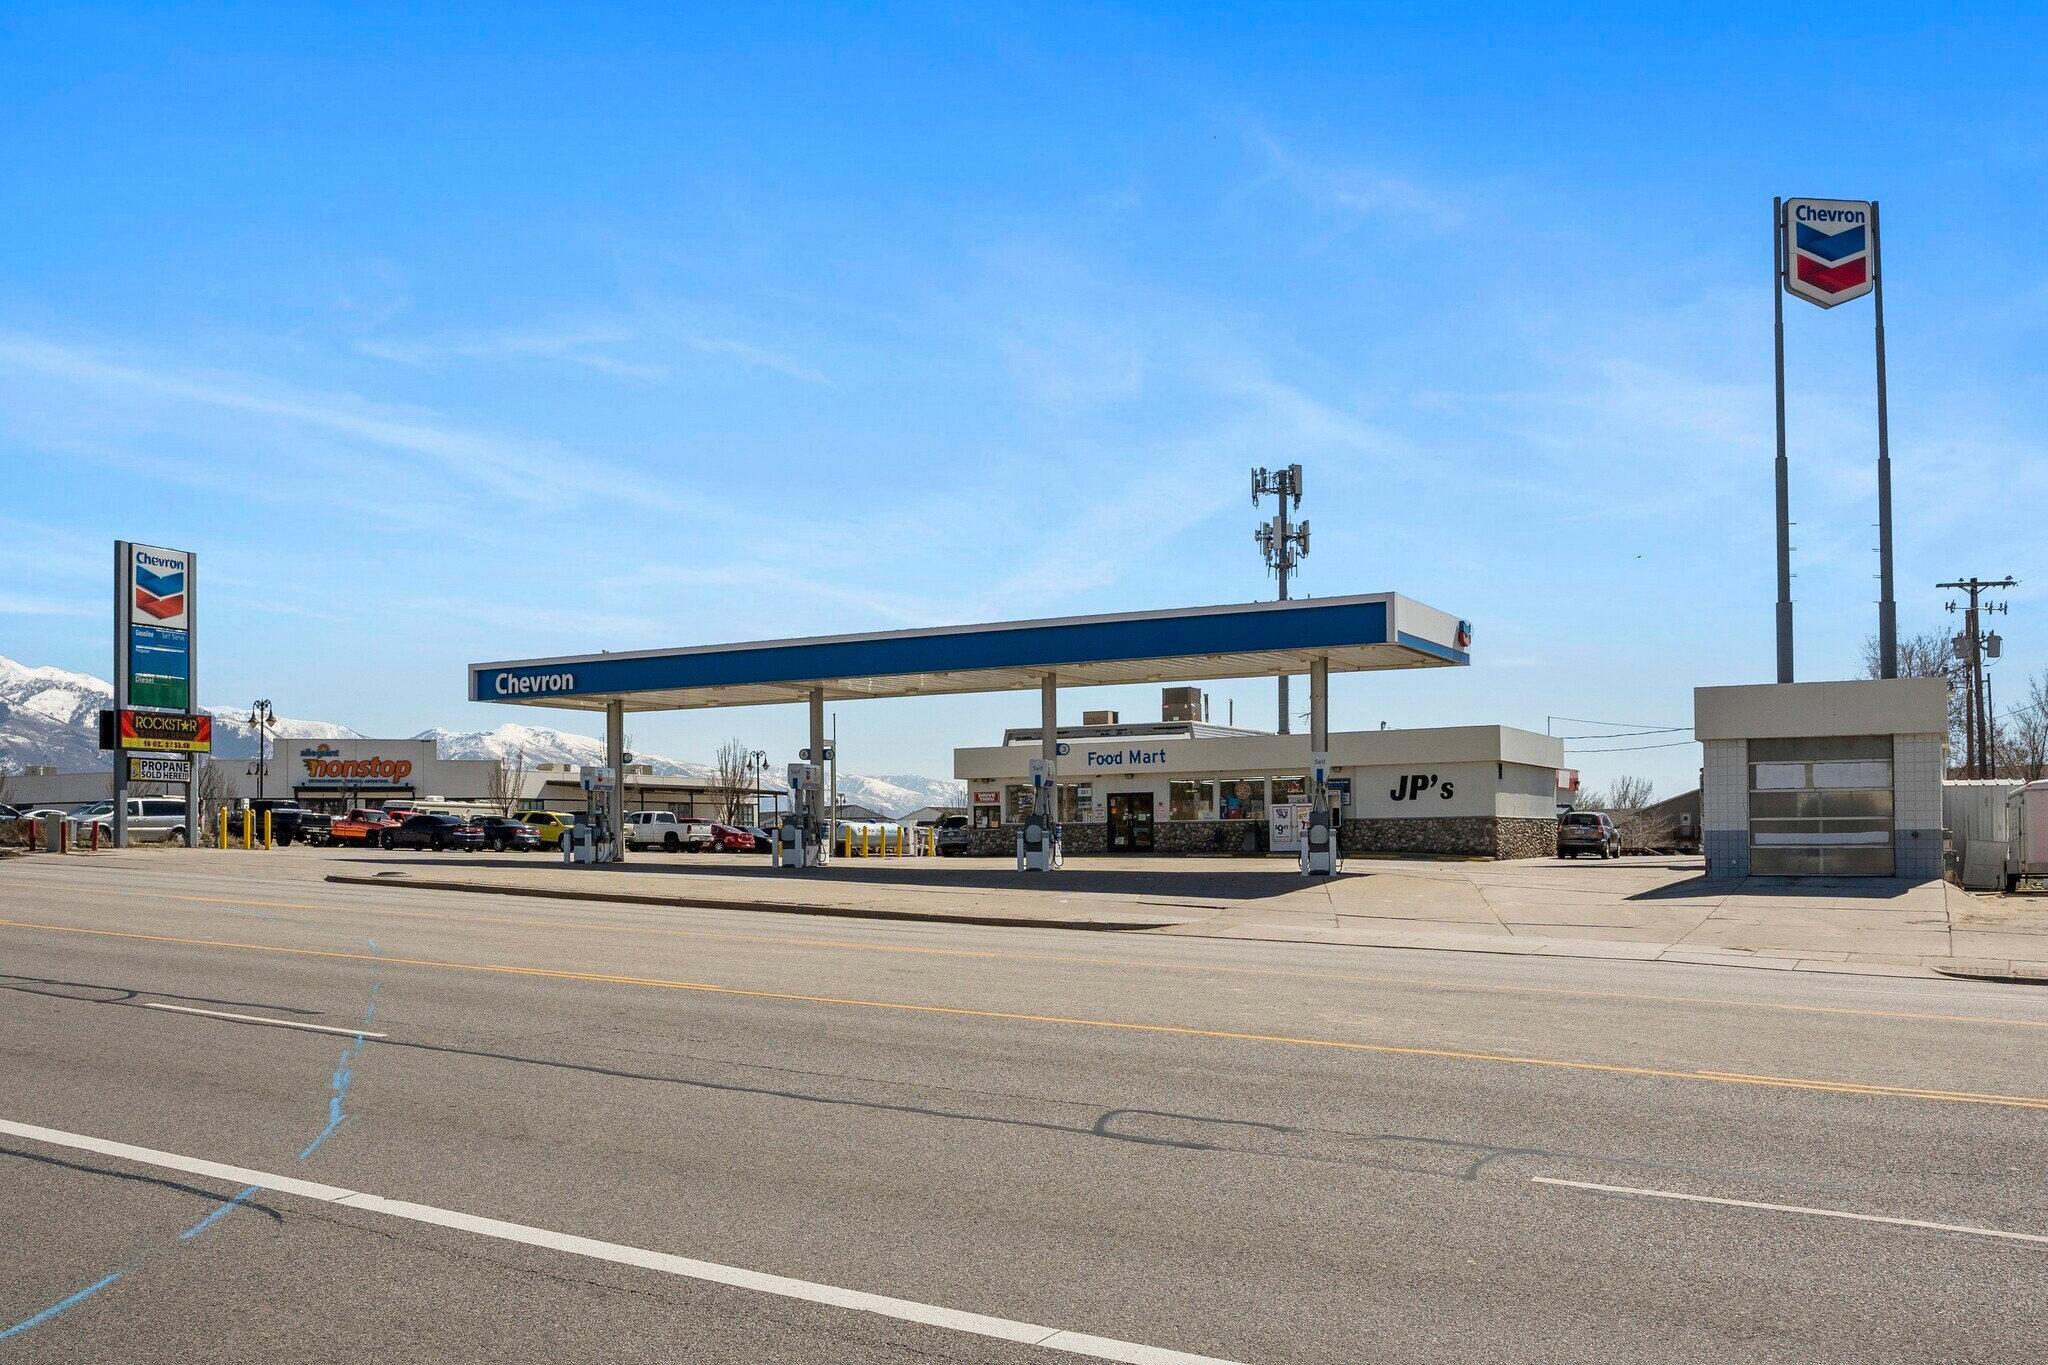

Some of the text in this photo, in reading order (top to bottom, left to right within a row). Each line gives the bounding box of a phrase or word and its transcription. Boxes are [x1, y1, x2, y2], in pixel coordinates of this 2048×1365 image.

[1796, 204, 1865, 223] Chevron
[136, 551, 184, 570] Chevron
[135, 629, 154, 638] Gasoline
[135, 675, 155, 685] Diesel
[495, 672, 574, 695] Chevron
[142, 761, 188, 772] PROPANE
[1088, 749, 1166, 766] Food Mart
[142, 770, 189, 780] SOLD HERE!!!
[309, 756, 412, 784] nonstop
[1390, 774, 1454, 802] JP's
